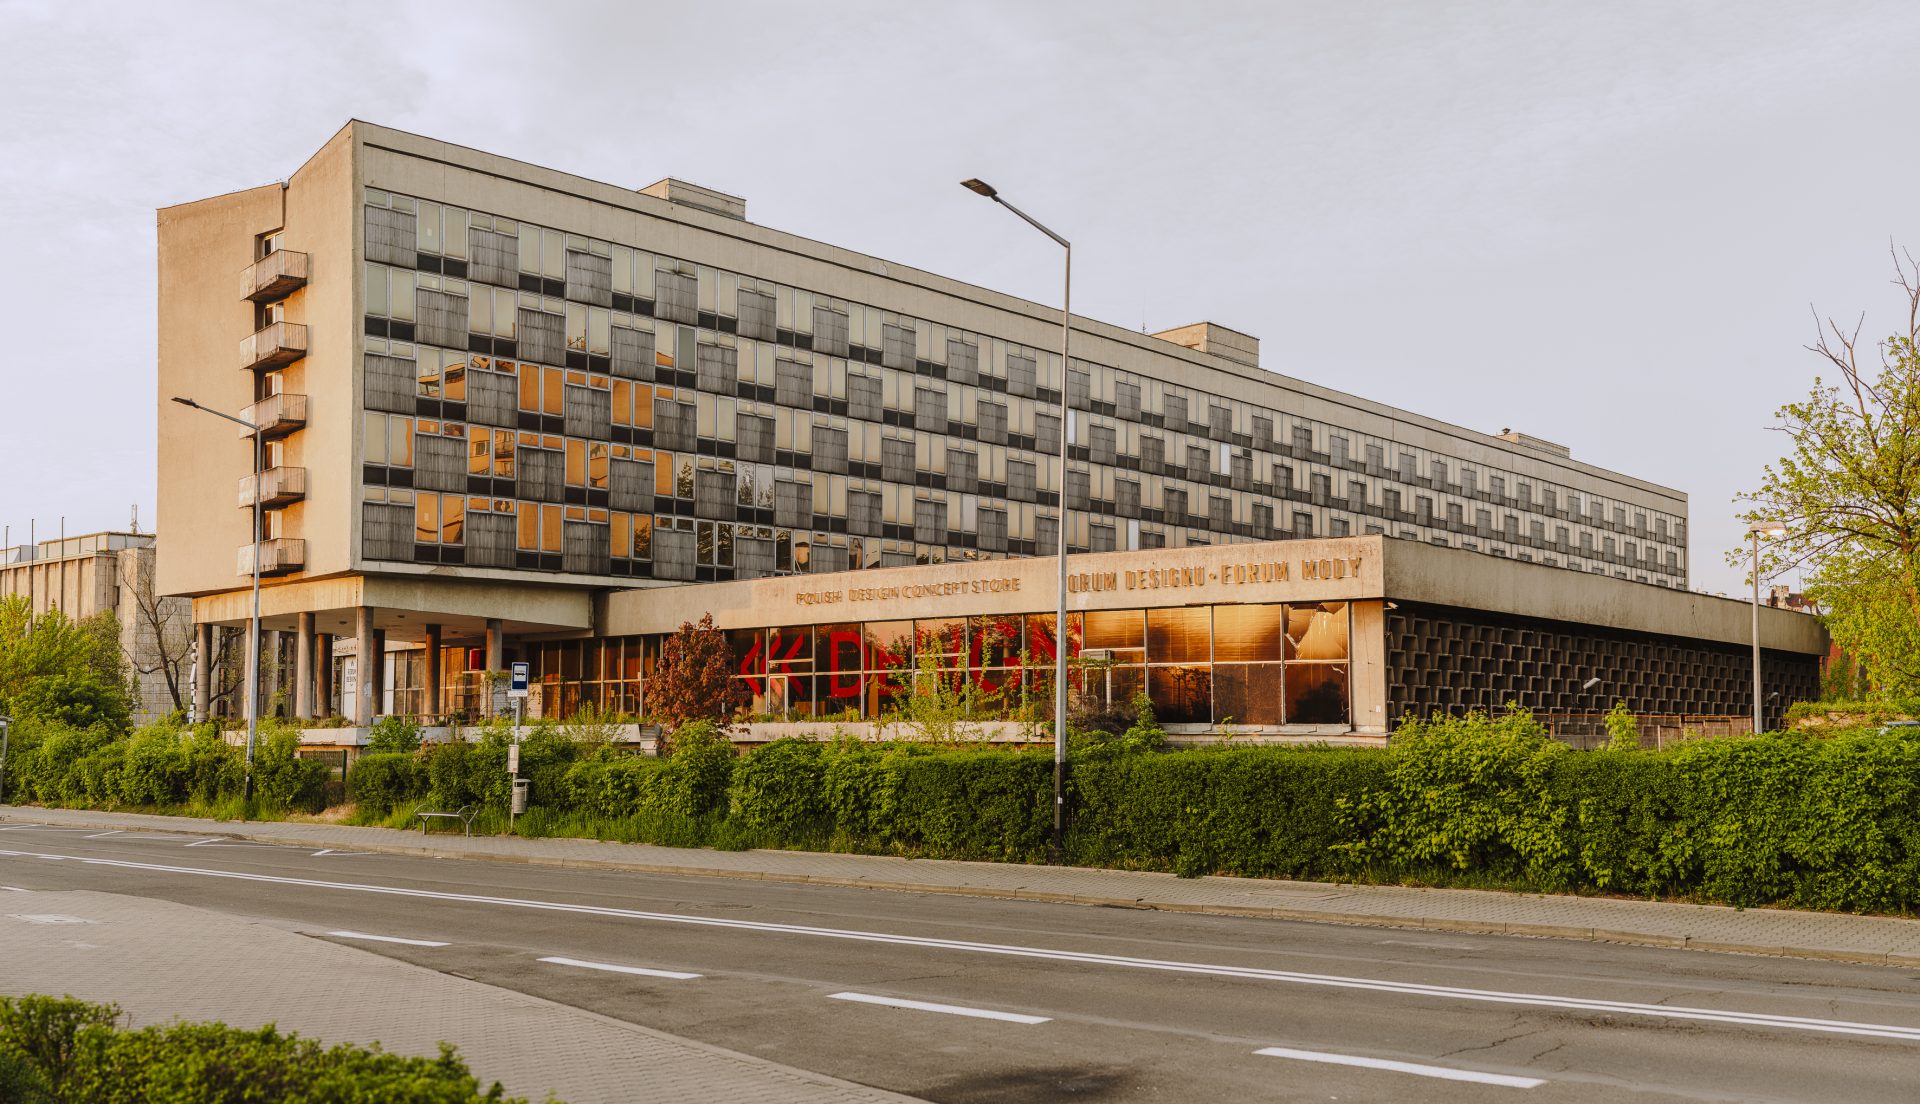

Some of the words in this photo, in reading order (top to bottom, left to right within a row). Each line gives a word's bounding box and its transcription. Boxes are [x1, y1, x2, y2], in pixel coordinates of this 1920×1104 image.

[1067, 572, 1117, 593] ORUM
[1125, 567, 1205, 590] DESIGNU
[1221, 561, 1289, 584] FORUM
[1301, 558, 1362, 579] MODY
[796, 590, 842, 605] POLISH
[848, 586, 899, 602] DESIGN
[901, 582, 969, 598] CONCEPT
[971, 578, 1020, 593] STORE
